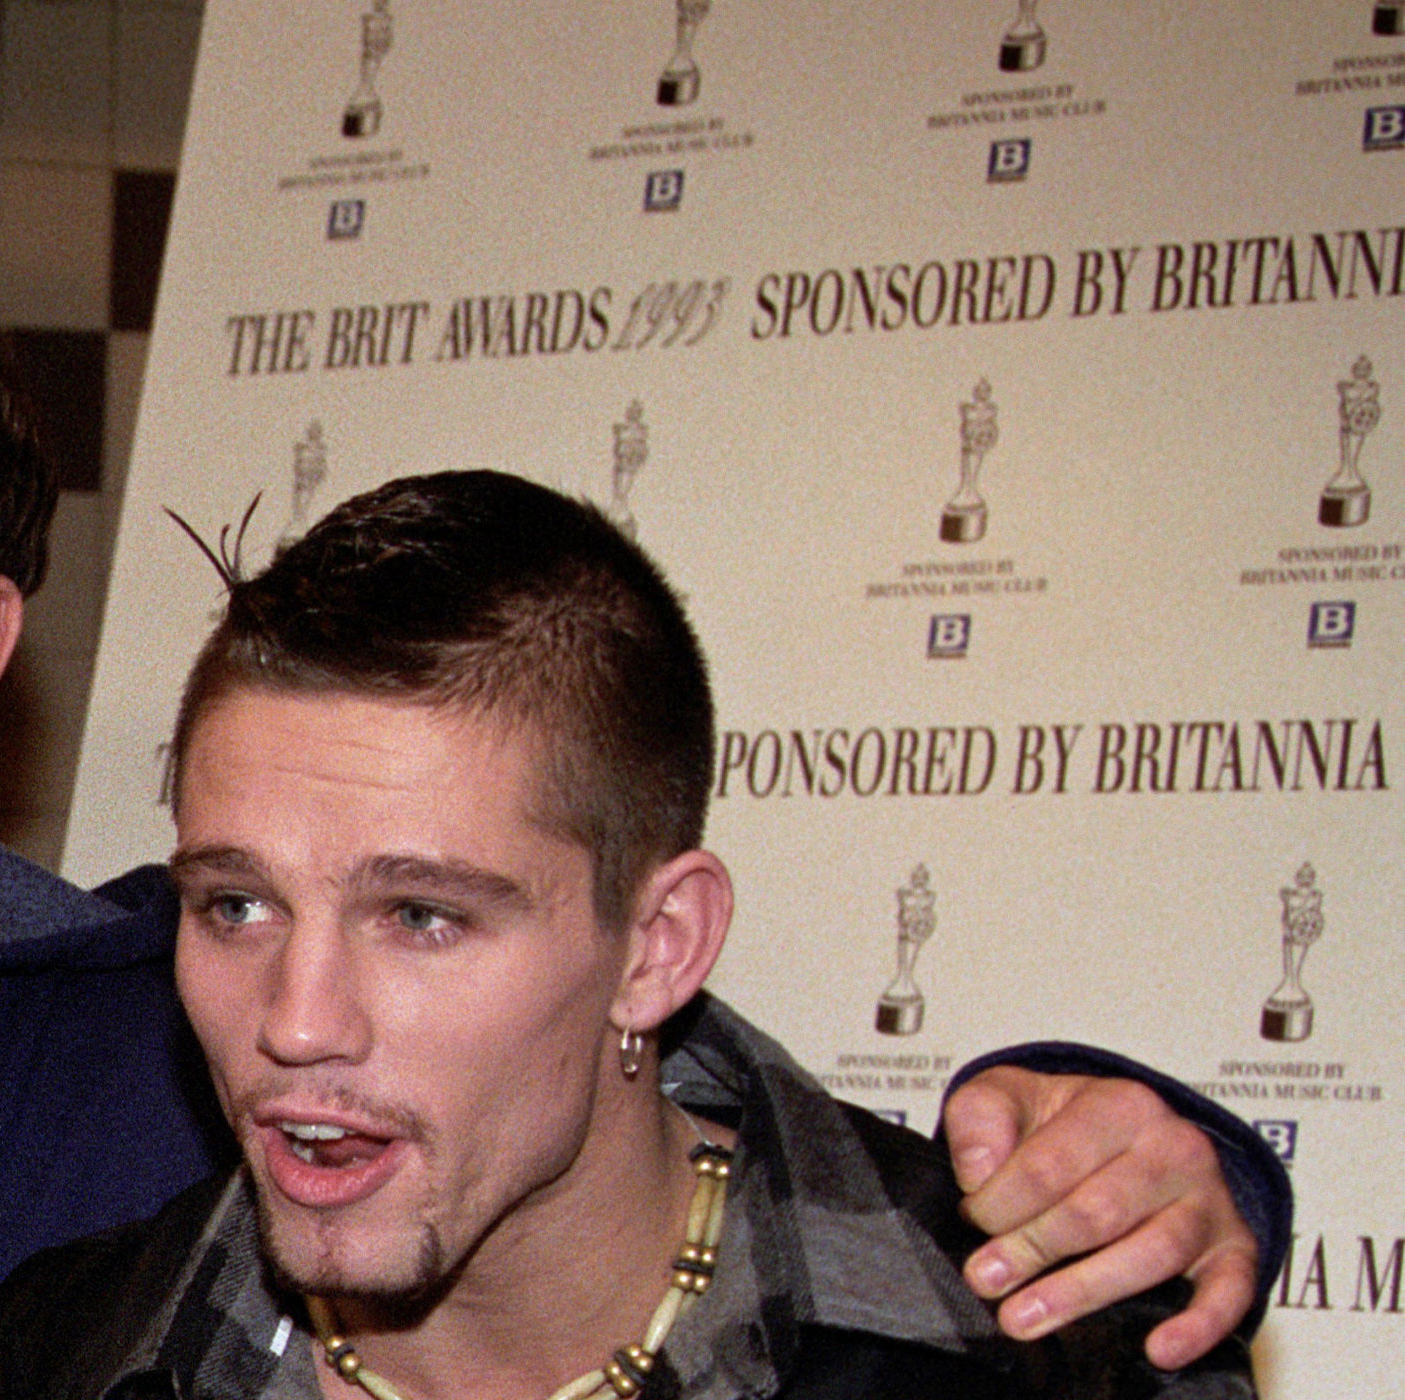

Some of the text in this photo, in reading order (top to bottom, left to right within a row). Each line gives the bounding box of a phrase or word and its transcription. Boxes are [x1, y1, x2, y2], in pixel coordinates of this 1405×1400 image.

[993, 141, 1027, 176] B
[225, 310, 316, 377] THE
[323, 301, 430, 370] BRIT
[433, 286, 613, 363] AWARDS
[613, 275, 731, 352] 1993
[751, 252, 1055, 345] SPONSORED
[1071, 245, 1139, 318] BY
[1278, 544, 1402, 563] SPONSORED BY
[1239, 568, 1327, 586] BRITANNIA
[1332, 565, 1388, 583] MUSIC
[933, 615, 967, 650] B
[1315, 603, 1351, 639] B
[716, 717, 1389, 798] PONSORED BY BRITANNIA
[1219, 1061, 1345, 1080] SPONSORED BY
[1274, 1084, 1329, 1100] MUSIC
[1333, 1086, 1383, 1102] CLUB
